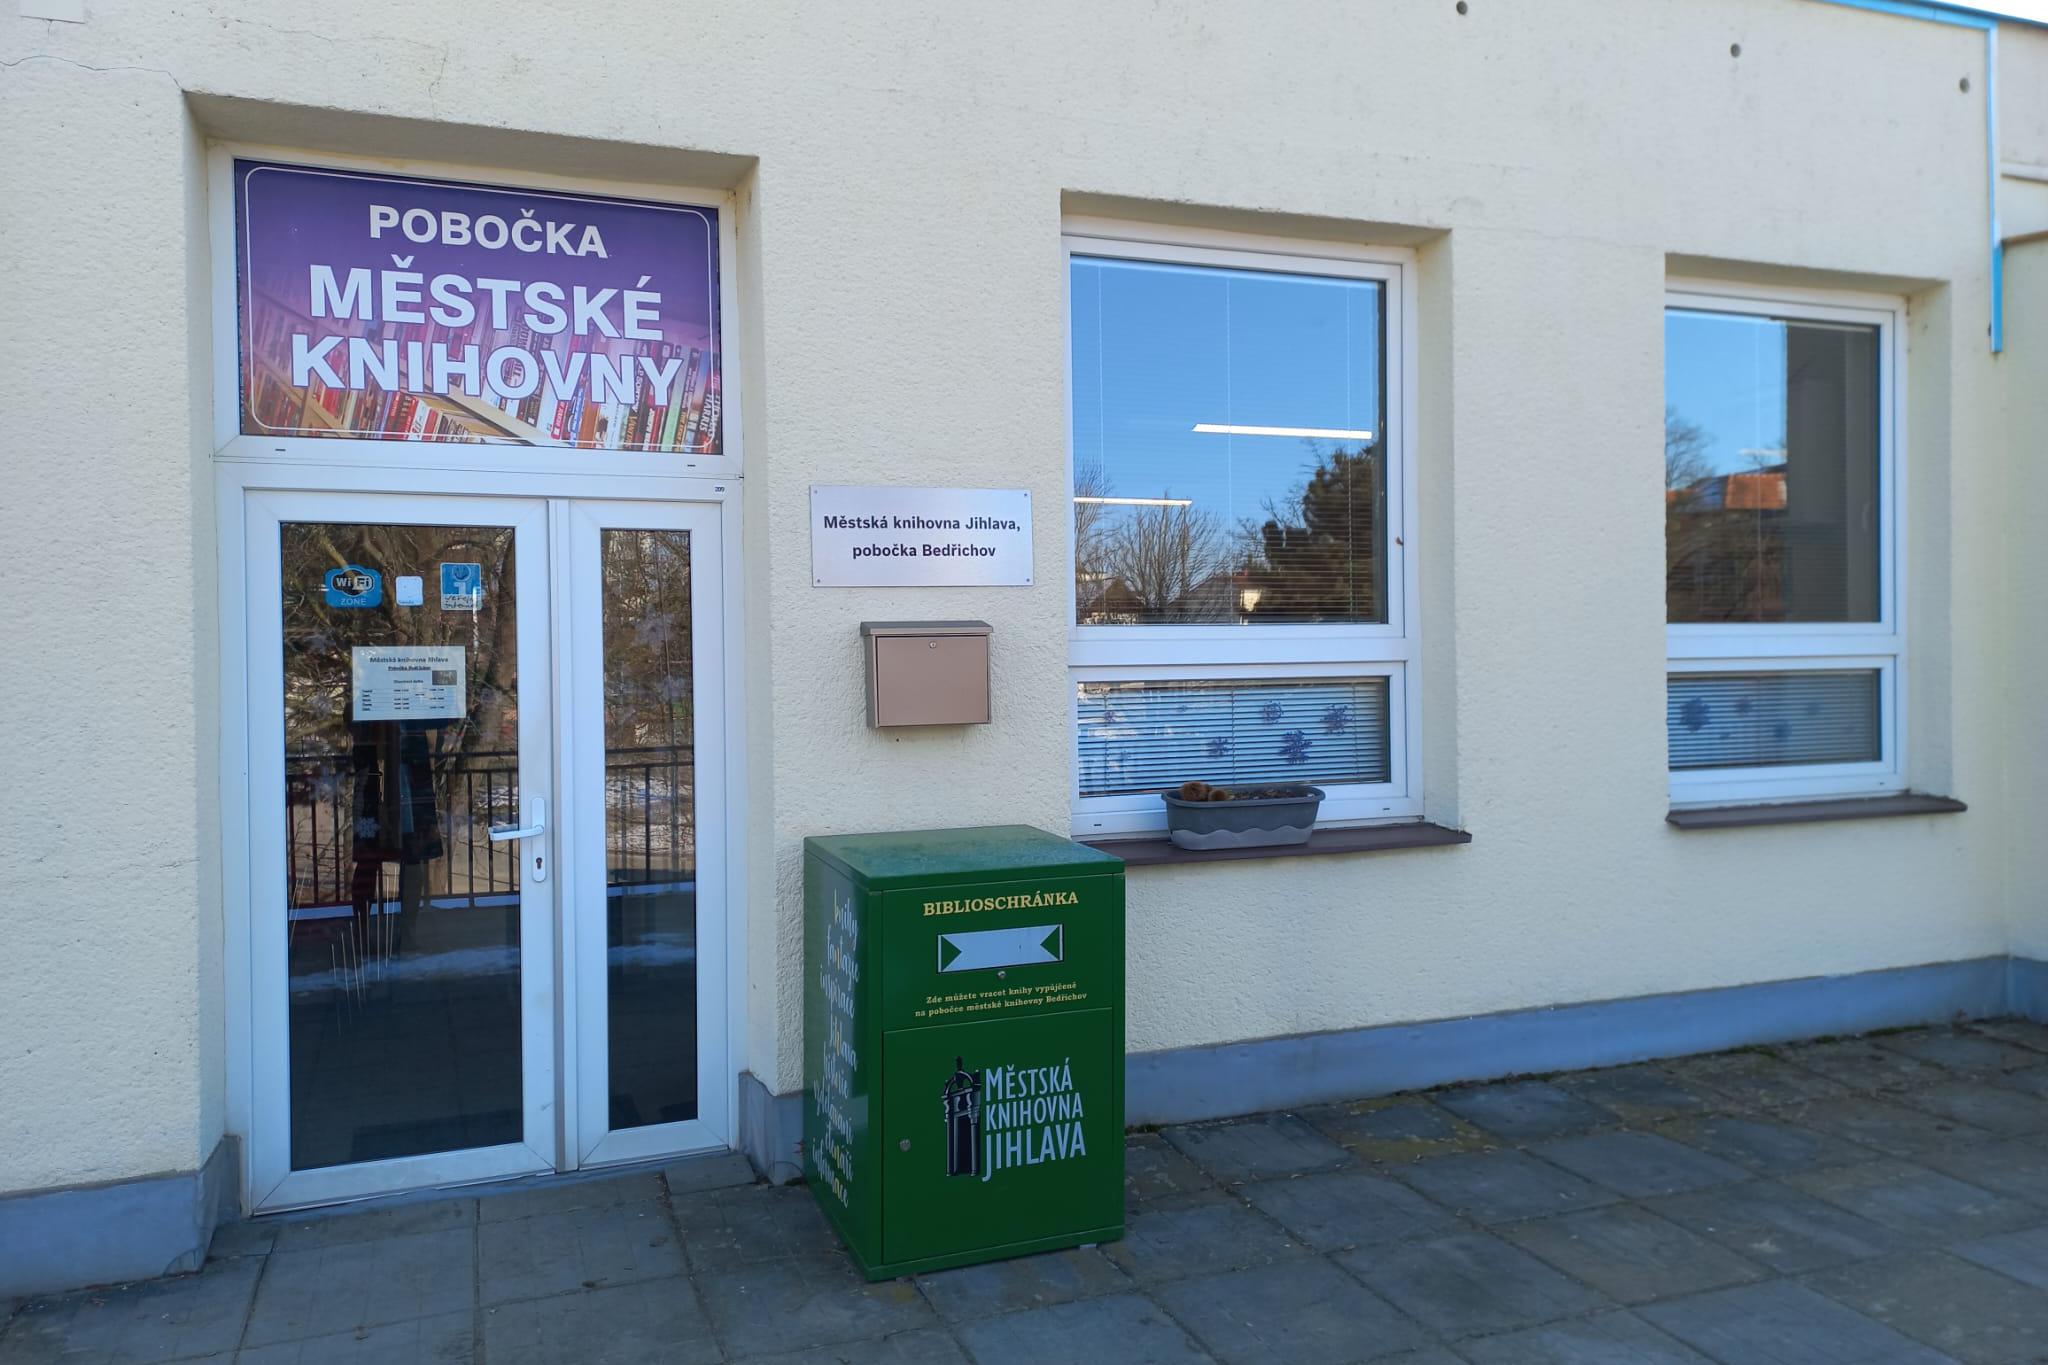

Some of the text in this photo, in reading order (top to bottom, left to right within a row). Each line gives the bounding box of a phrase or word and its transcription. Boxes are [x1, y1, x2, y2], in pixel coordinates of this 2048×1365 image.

[369, 204, 609, 259] POBOČKA
[309, 254, 663, 341] MĚSTSKÉ
[290, 333, 684, 407] KNIHOVNY
[824, 515, 1021, 532] Městská knihovna Jihlava,
[852, 543, 996, 560] pobočka Bedřichov
[340, 598, 367, 606] ZONE
[834, 888, 858, 951] knihy
[923, 890, 1079, 917] BIBLIOSCHRÁNKA
[915, 992, 1088, 1018] na pobočce městské knihovny Bedřichov
[926, 996, 942, 1004] Zde
[979, 989, 1006, 998] vracet
[1008, 986, 1033, 996] knihy
[985, 1057, 1073, 1102] MĚSTSKÁ
[985, 1092, 1084, 1131] KNIHOVNA
[982, 1121, 1086, 1182] JIHLAVA
